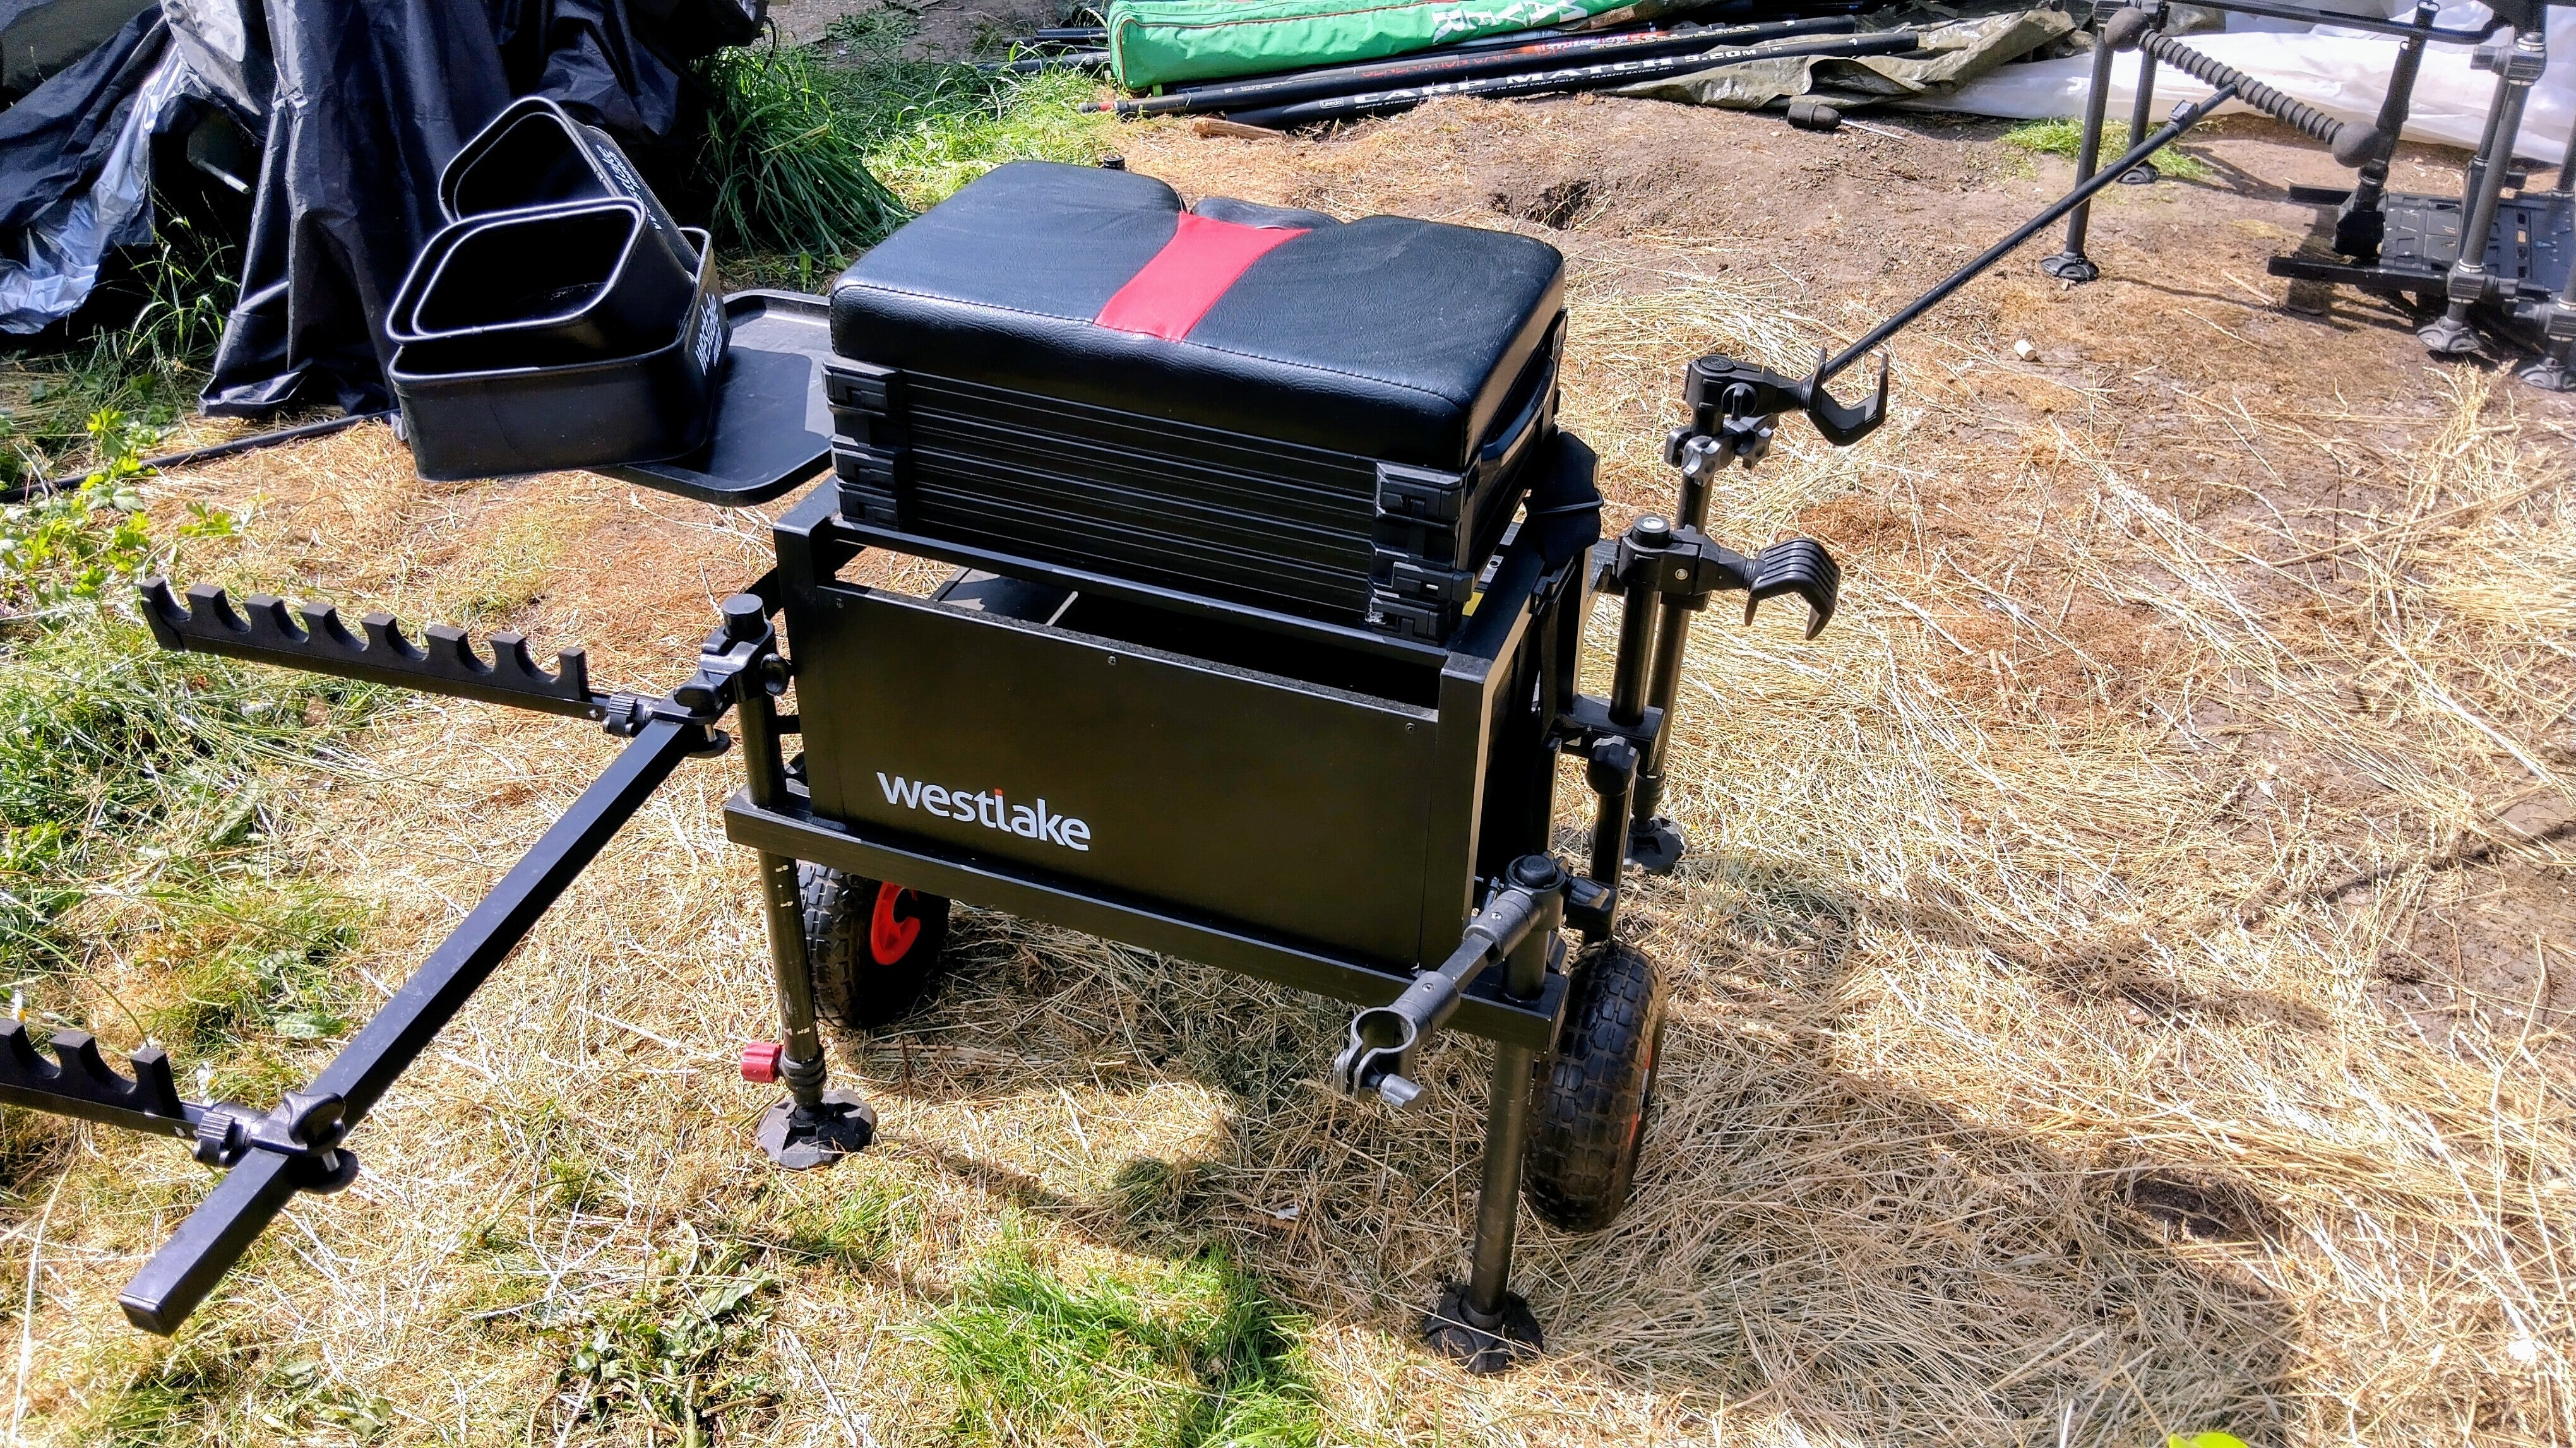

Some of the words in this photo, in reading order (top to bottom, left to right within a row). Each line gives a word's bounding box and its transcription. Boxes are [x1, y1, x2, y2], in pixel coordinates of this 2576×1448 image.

[1320, 100, 1343, 108] Leeda
[1354, 80, 1486, 103] CARP
[1506, 57, 1673, 84] MATCH
[1684, 49, 1757, 62] 9.20M
[597, 145, 662, 229] wstlake
[695, 293, 718, 376] westlake
[876, 771, 1092, 852] westlake
